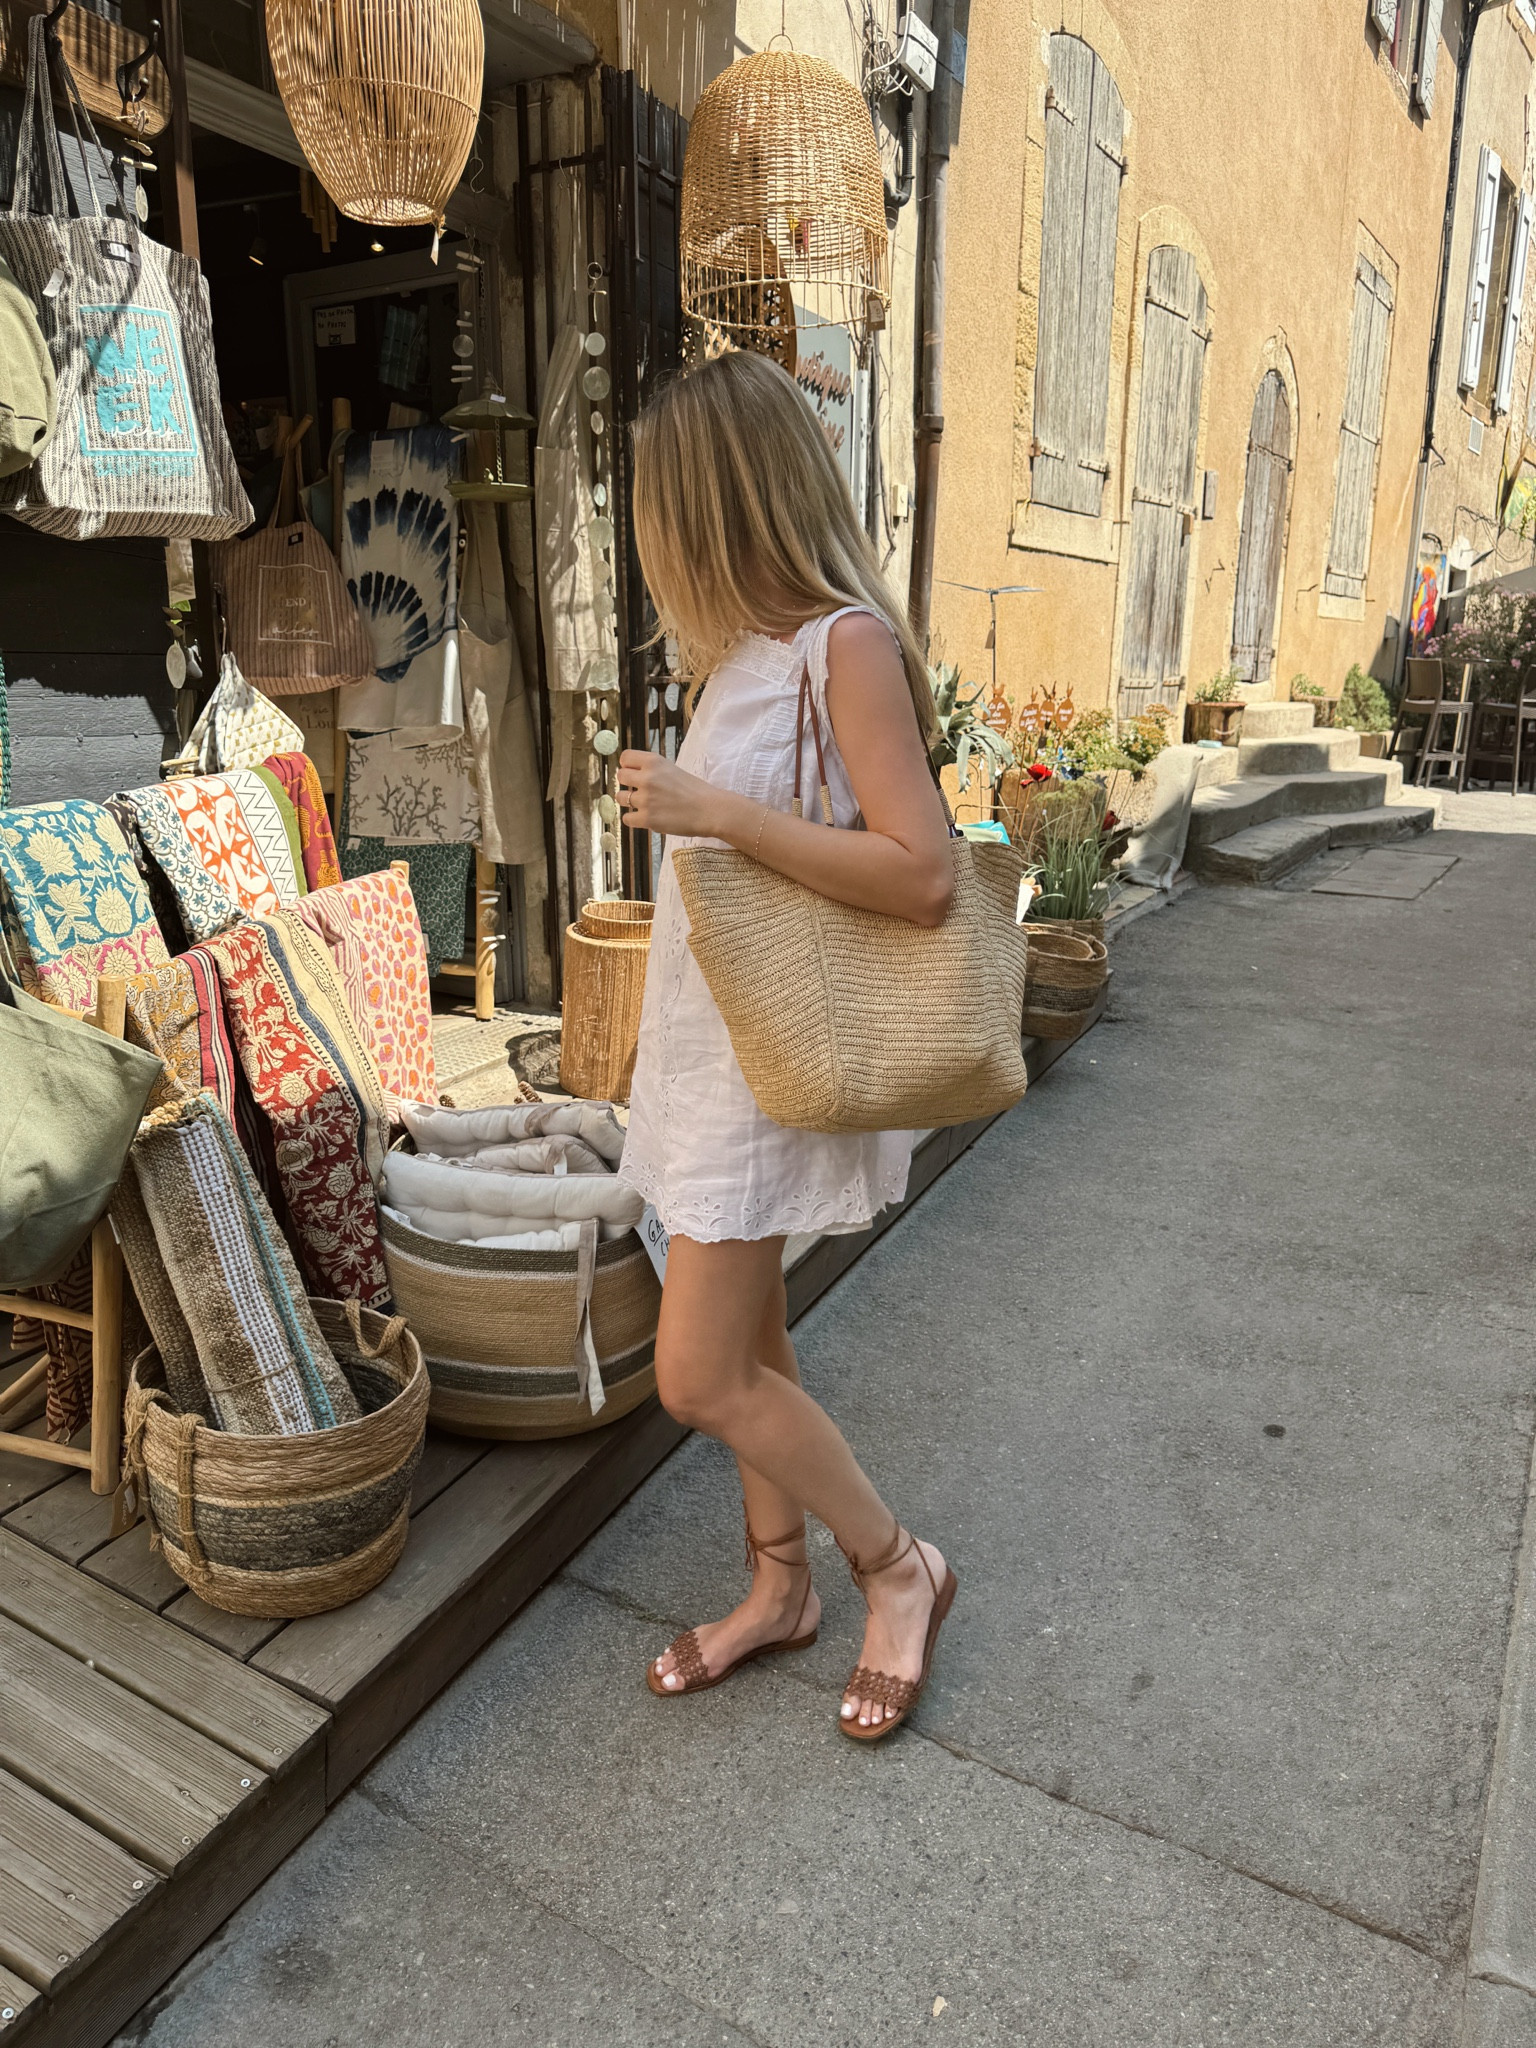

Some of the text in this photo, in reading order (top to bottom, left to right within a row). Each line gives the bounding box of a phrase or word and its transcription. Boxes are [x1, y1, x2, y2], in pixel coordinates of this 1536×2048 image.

[85, 321, 168, 378] WE
[123, 369, 156, 384] END
[96, 379, 183, 435] EK
[286, 597, 307, 607] END
